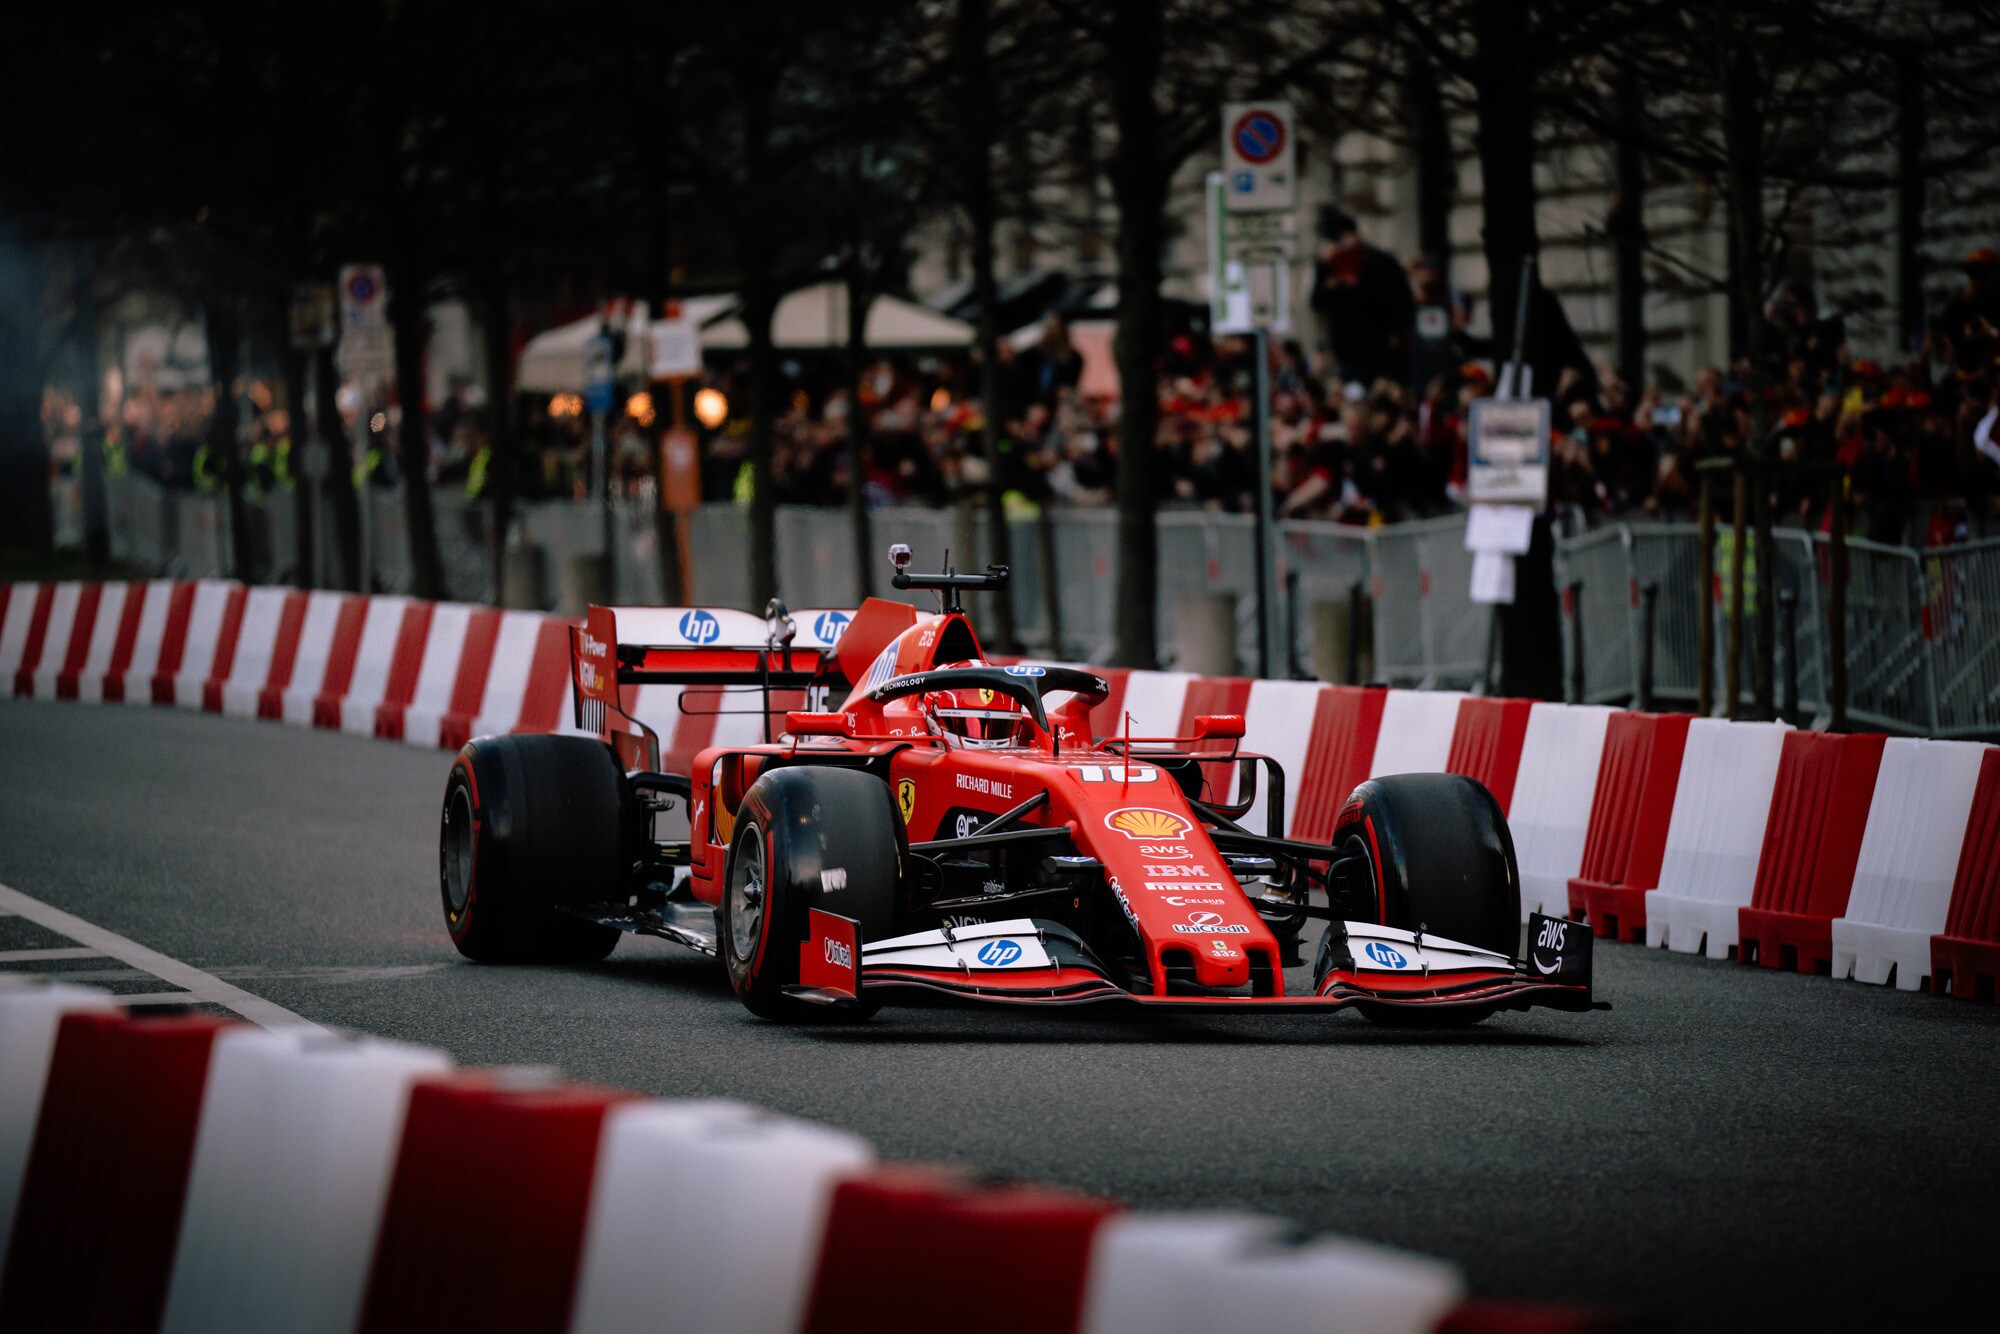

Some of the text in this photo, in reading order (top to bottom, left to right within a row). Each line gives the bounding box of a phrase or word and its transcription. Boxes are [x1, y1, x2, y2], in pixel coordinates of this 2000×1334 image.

[683, 609, 717, 645] hp
[884, 677, 926, 693] TECHNOLOGY
[956, 773, 1013, 799] RICHARD MILLE
[1139, 845, 1189, 854] aws
[1142, 865, 1210, 877] IBM
[1144, 882, 1224, 891] PIRELLI
[1173, 924, 1250, 934] UniCredit
[1537, 918, 1568, 951] aws
[980, 940, 1020, 967] hp
[1211, 949, 1239, 957] 332
[1369, 943, 1403, 969] hp
